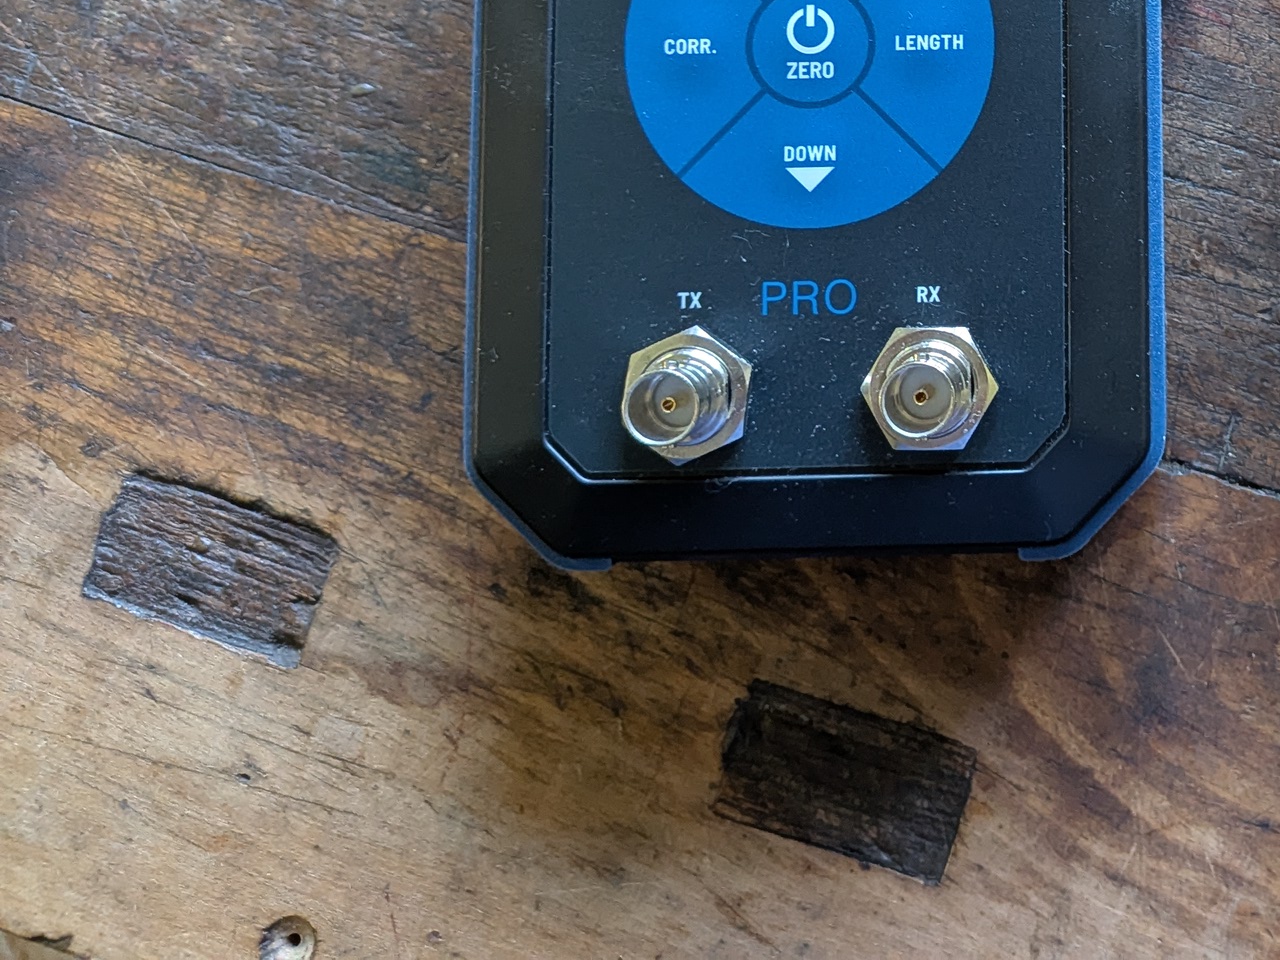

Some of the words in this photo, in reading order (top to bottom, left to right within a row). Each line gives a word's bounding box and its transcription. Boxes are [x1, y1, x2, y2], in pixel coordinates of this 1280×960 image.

[663, 37, 717, 56] CORR.
[895, 34, 965, 52] LENGTH
[786, 61, 835, 79] ZERO
[783, 145, 837, 162] DOWN
[677, 291, 702, 309] TX
[761, 278, 857, 316] PRO
[916, 285, 941, 303] RX
